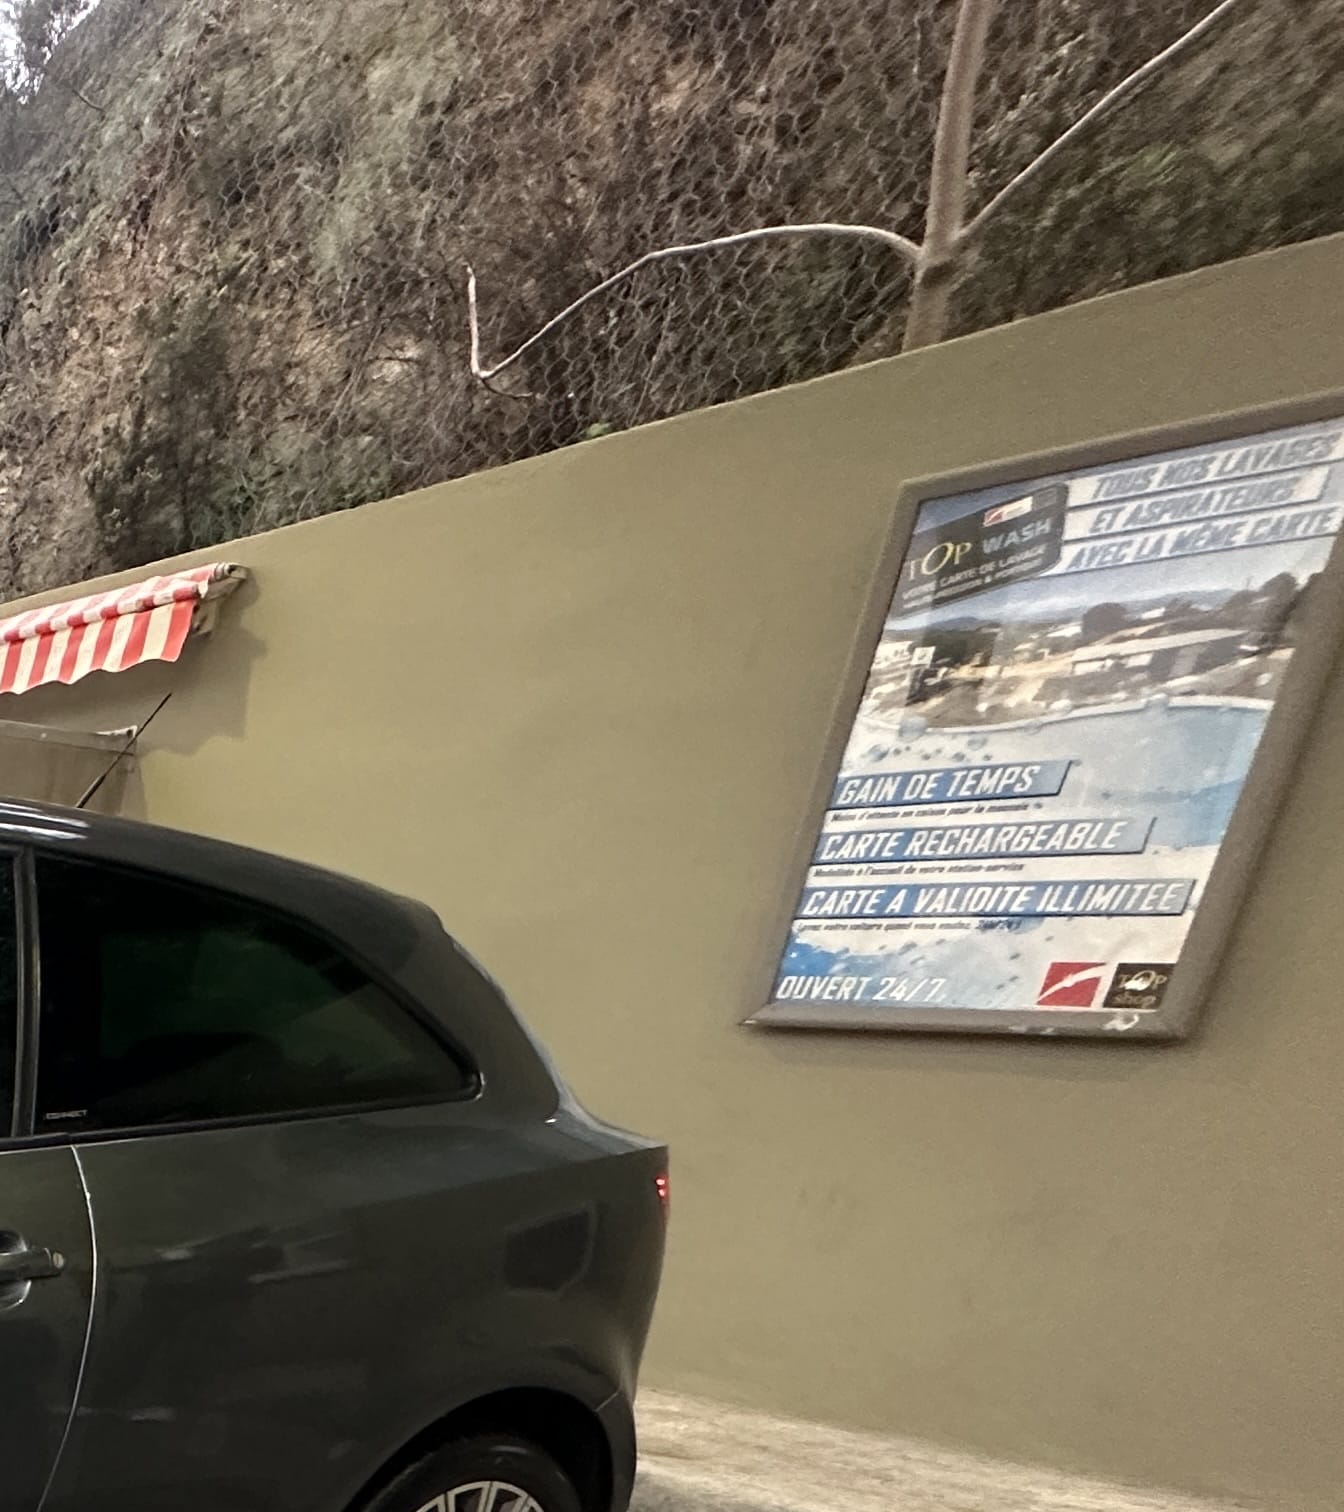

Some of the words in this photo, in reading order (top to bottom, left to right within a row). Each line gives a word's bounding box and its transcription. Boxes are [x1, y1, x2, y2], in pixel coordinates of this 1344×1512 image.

[1092, 466, 1160, 500] TOUS
[1159, 455, 1216, 488] NOS
[1215, 432, 1343, 478] LAVAGES
[1089, 506, 1126, 534] ET
[1122, 476, 1301, 528] ASPIRATEURS
[982, 517, 1052, 553] WASH
[1066, 539, 1135, 570] AVEC
[1133, 533, 1169, 561] LA
[1250, 506, 1339, 541] CARTE
[836, 776, 902, 805] GAIN
[903, 772, 944, 800] DE
[946, 765, 1040, 797] TEMPS
[820, 832, 905, 860] CARTE
[904, 821, 1128, 856] RECHARGEABLE
[802, 889, 887, 915] CARTE
[885, 888, 908, 914] A
[913, 885, 1036, 913] VALIDITE
[1036, 883, 1185, 913] ILLIMITEE
[777, 975, 872, 1001] OUVERT
